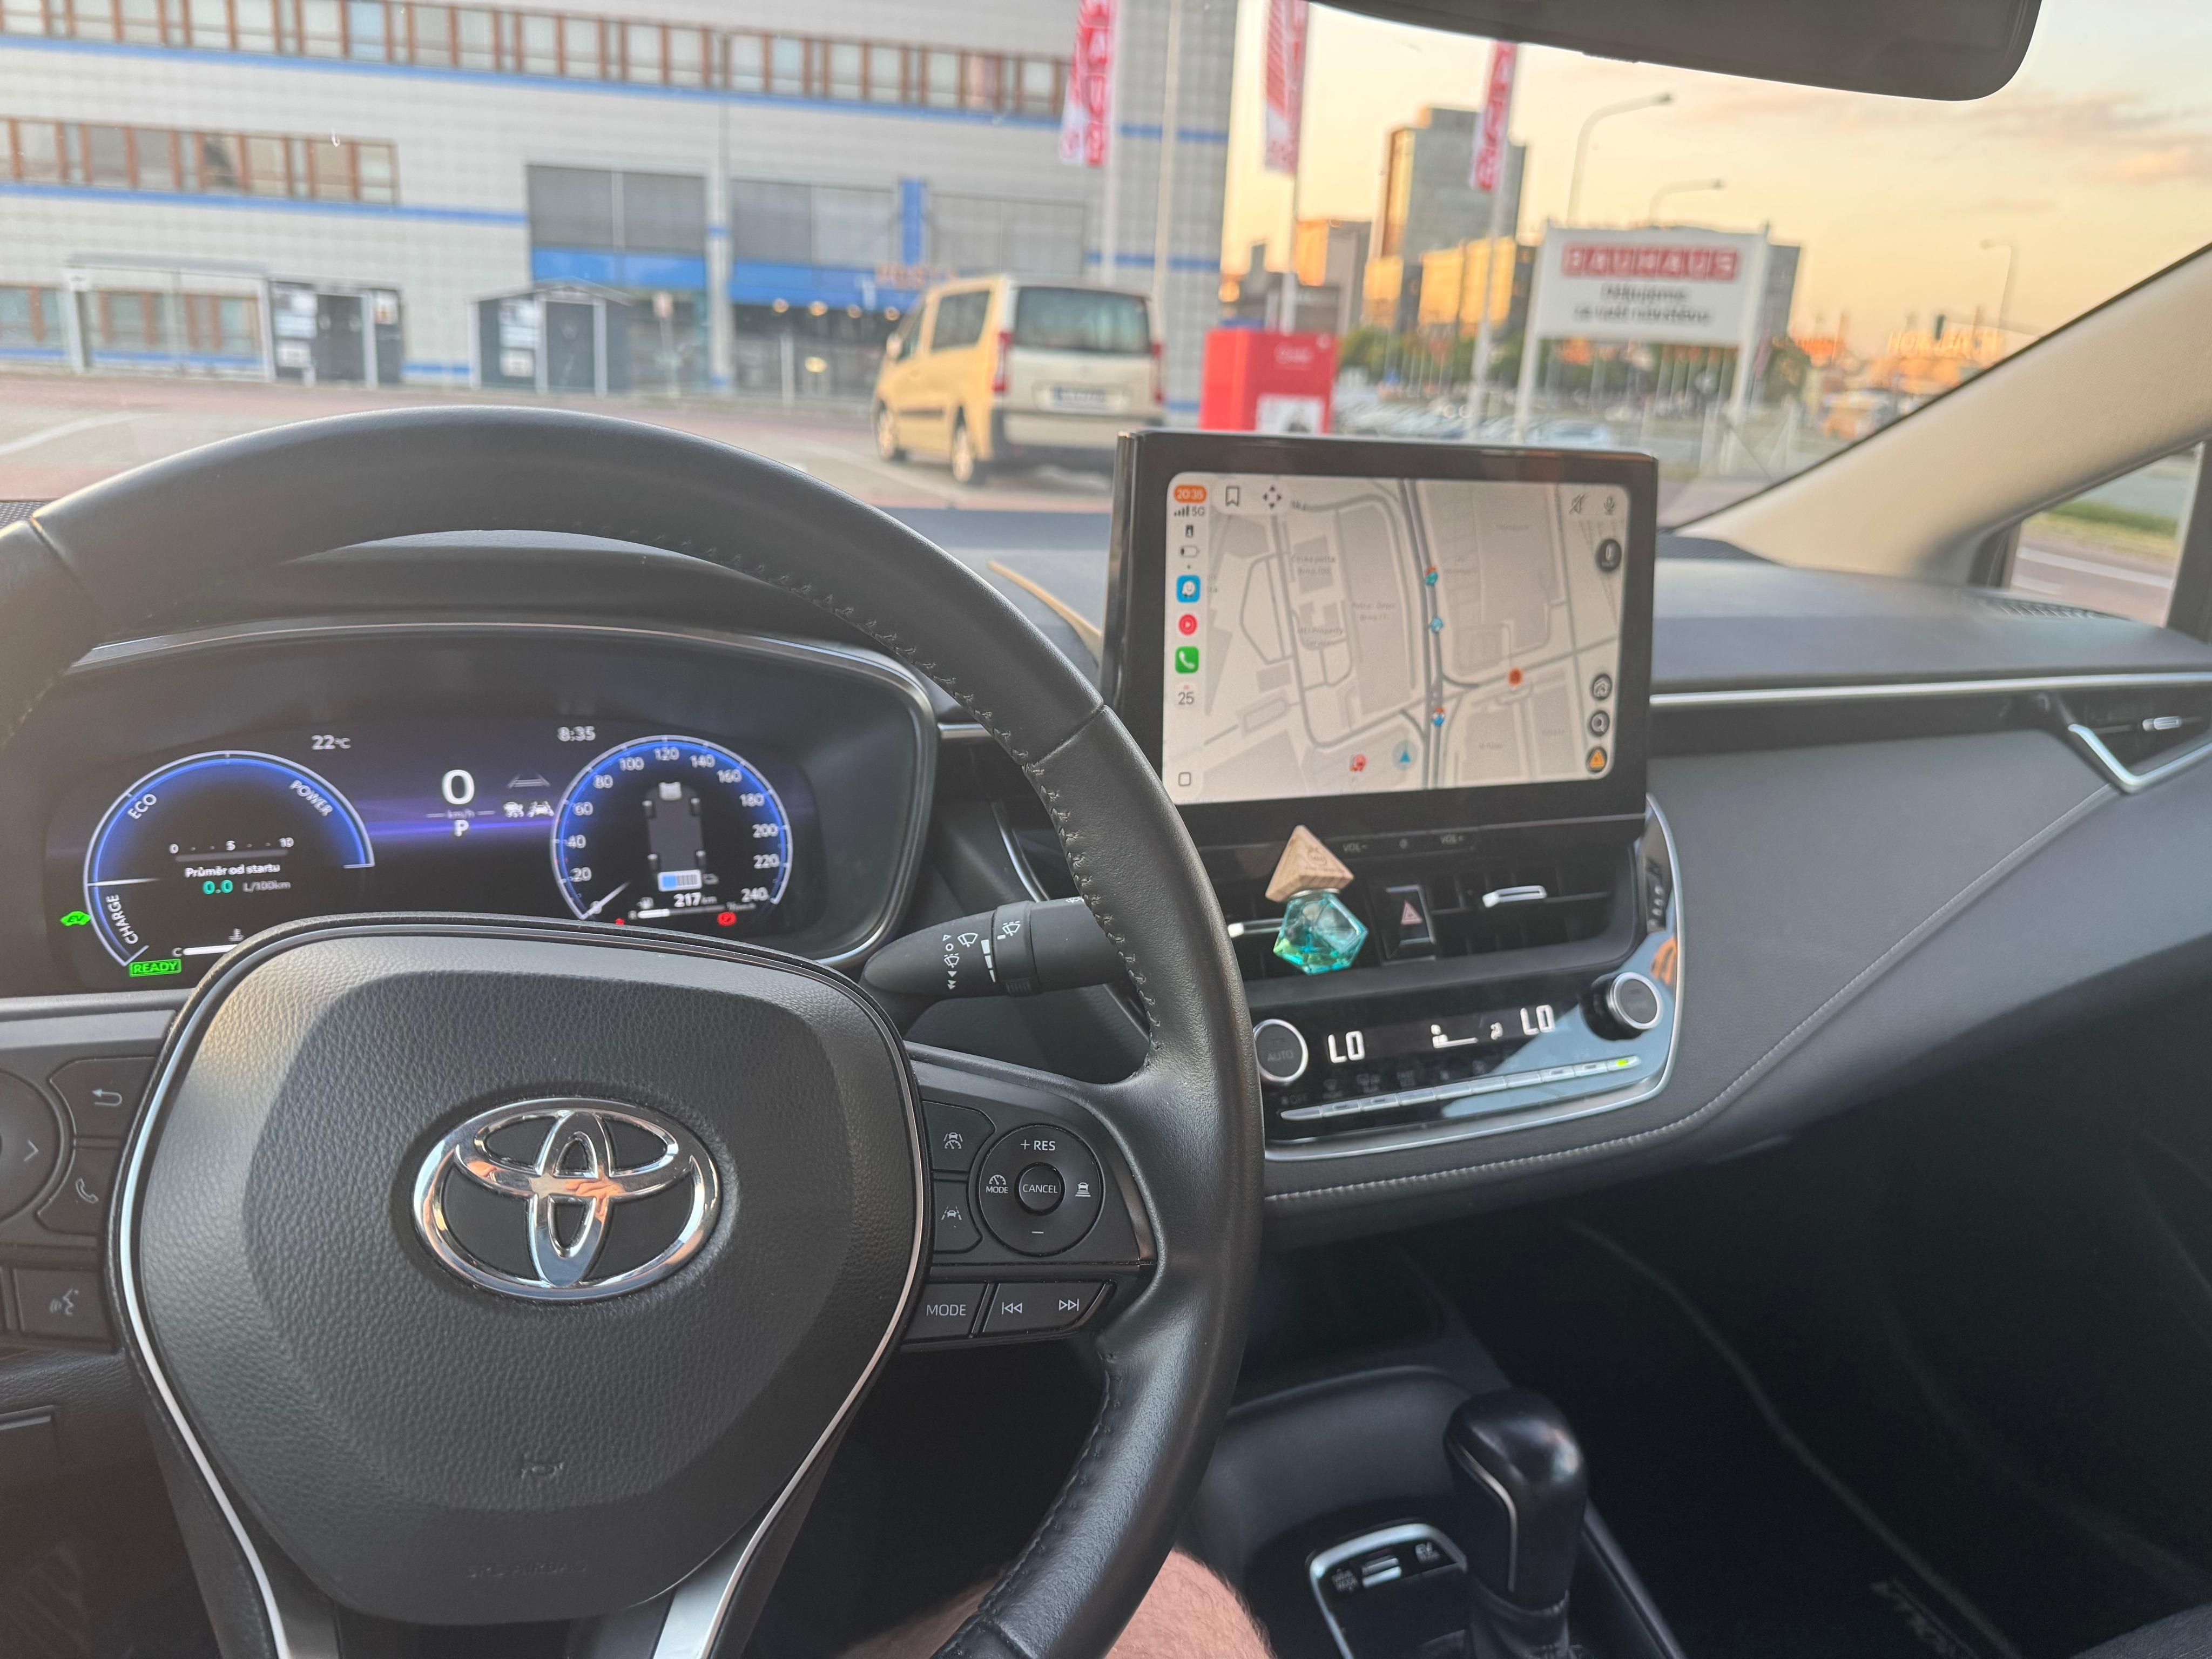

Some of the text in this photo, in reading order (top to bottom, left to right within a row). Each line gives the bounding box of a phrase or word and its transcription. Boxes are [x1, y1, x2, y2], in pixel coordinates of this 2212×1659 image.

[1564, 243, 1740, 282] BAUHAUS
[1191, 506, 1205, 517] 5G
[1178, 691, 1194, 705] 25
[557, 726, 596, 742] 8:35
[654, 747, 679, 761] 120
[690, 754, 716, 767] 140
[619, 757, 645, 771] 100
[594, 774, 613, 789] 80
[716, 768, 743, 783] 160
[442, 769, 475, 804] 0
[288, 779, 333, 817] POWER
[739, 793, 765, 807] 180
[127, 793, 157, 820] ECO
[573, 801, 594, 816] 60
[454, 819, 469, 837] P
[752, 823, 778, 838] 200
[168, 837, 294, 854] 0 5 10
[567, 834, 586, 848] 40
[753, 853, 780, 869] 220
[228, 864, 245, 875] od
[246, 864, 281, 874] startu
[571, 867, 592, 882] 20
[203, 879, 233, 894] 0.0
[673, 892, 702, 907] 217
[740, 887, 769, 902] 240
[105, 893, 139, 945] CHARGE
[171, 947, 184, 957] C
[132, 961, 178, 974] READY
[1520, 1004, 1554, 1035] LO
[1328, 1030, 1365, 1064] LO
[1267, 1049, 1293, 1062] AUTO
[1033, 1139, 1056, 1152] RES
[986, 1185, 1008, 1194] MODE
[1022, 1183, 1058, 1194] CANCEL
[926, 1304, 967, 1317] MODE
